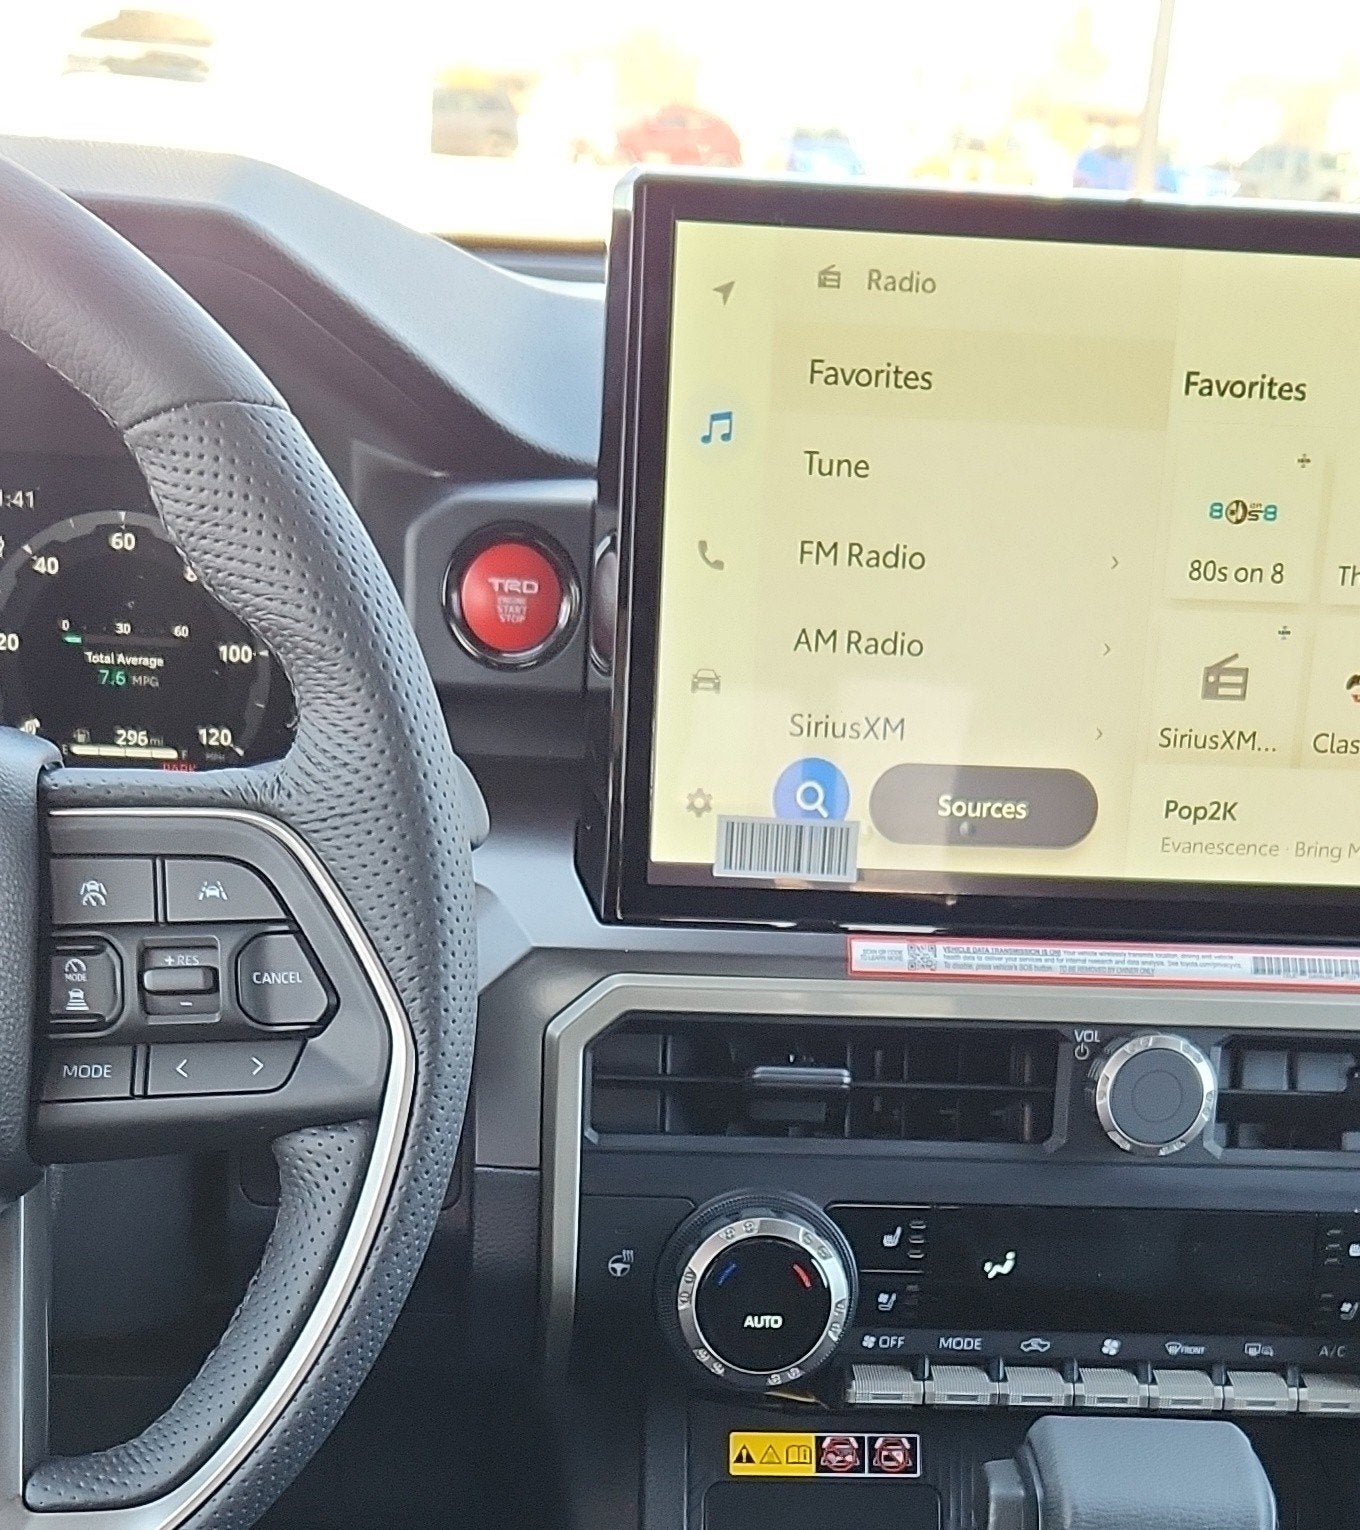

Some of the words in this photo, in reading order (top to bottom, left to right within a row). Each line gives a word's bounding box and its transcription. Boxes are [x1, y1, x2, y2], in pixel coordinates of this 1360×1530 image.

[867, 269, 937, 295] Radio
[808, 359, 933, 391] Favorites
[1184, 371, 1307, 402] Favorites
[804, 450, 871, 479] Tune
[109, 533, 136, 551] 60
[799, 540, 839, 567] FM
[847, 542, 926, 571] Radio
[33, 557, 59, 575] 40
[1188, 559, 1228, 582] 80s
[1234, 567, 1263, 583] on
[1270, 562, 1284, 584] 8
[487, 578, 538, 594] TRD
[61, 620, 70, 631] 0
[115, 623, 131, 635] 30
[173, 625, 189, 638] 60
[793, 629, 837, 654] AM
[846, 630, 925, 658] Radio
[85, 652, 115, 666] Total
[117, 654, 164, 668] Average
[219, 645, 253, 663] 100
[98, 669, 127, 686] 7.6
[132, 675, 159, 688] MPG
[788, 713, 906, 741] SiriusXM
[115, 729, 148, 746] 296
[149, 735, 164, 747] mi
[198, 728, 232, 746] 120
[1159, 728, 1277, 754] SiriusXM...
[938, 795, 1028, 822] Sources
[1164, 800, 1238, 825] Pop2K
[1161, 837, 1280, 857] Evanescence
[1295, 840, 1342, 863] Bring
[65, 974, 87, 982] MODE
[253, 971, 303, 984] CANCEL
[1074, 1030, 1100, 1043] VOL
[62, 1065, 112, 1079] MODE
[744, 1315, 783, 1329] AUTO
[879, 1336, 905, 1349] OFF
[939, 1337, 982, 1351] MODE
[1319, 1345, 1346, 1358] A/C
